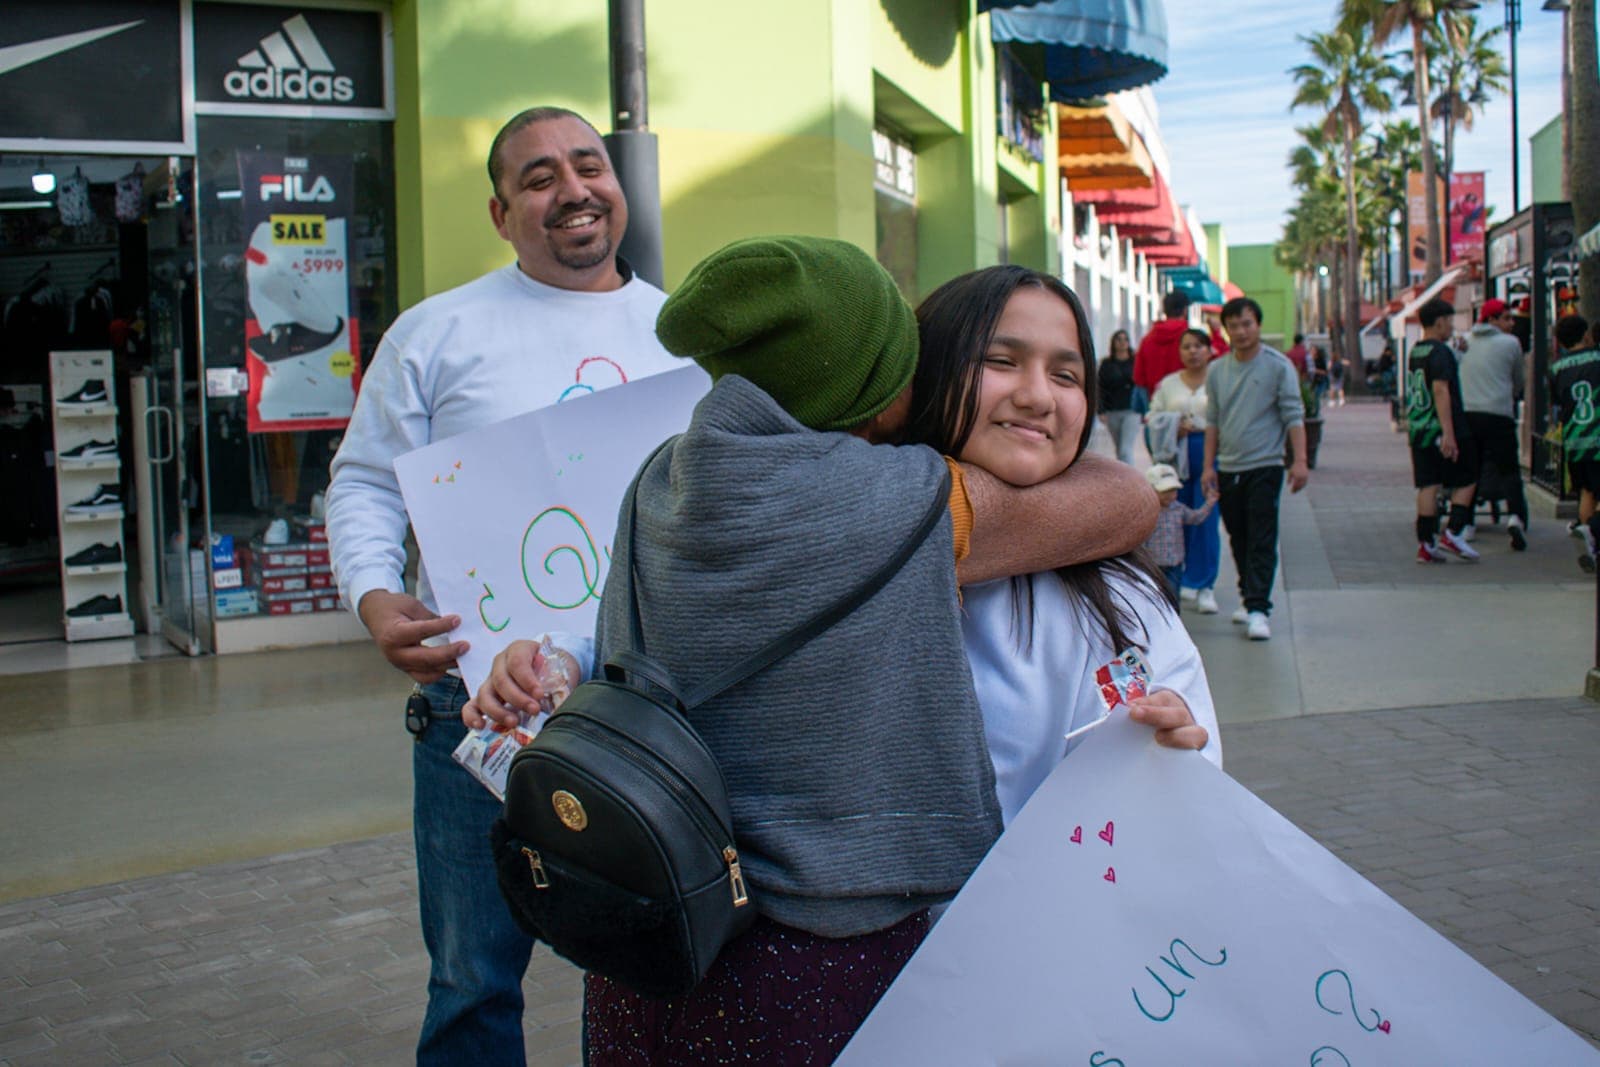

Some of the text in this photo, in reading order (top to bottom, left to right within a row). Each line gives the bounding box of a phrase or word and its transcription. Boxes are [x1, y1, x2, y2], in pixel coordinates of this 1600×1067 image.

[224, 65, 354, 101] adidas
[261, 174, 335, 201] FILA
[274, 222, 323, 239] SALE
[1571, 380, 1594, 425] 3
[214, 555, 233, 563] VISA
[1131, 938, 1227, 1022] un
